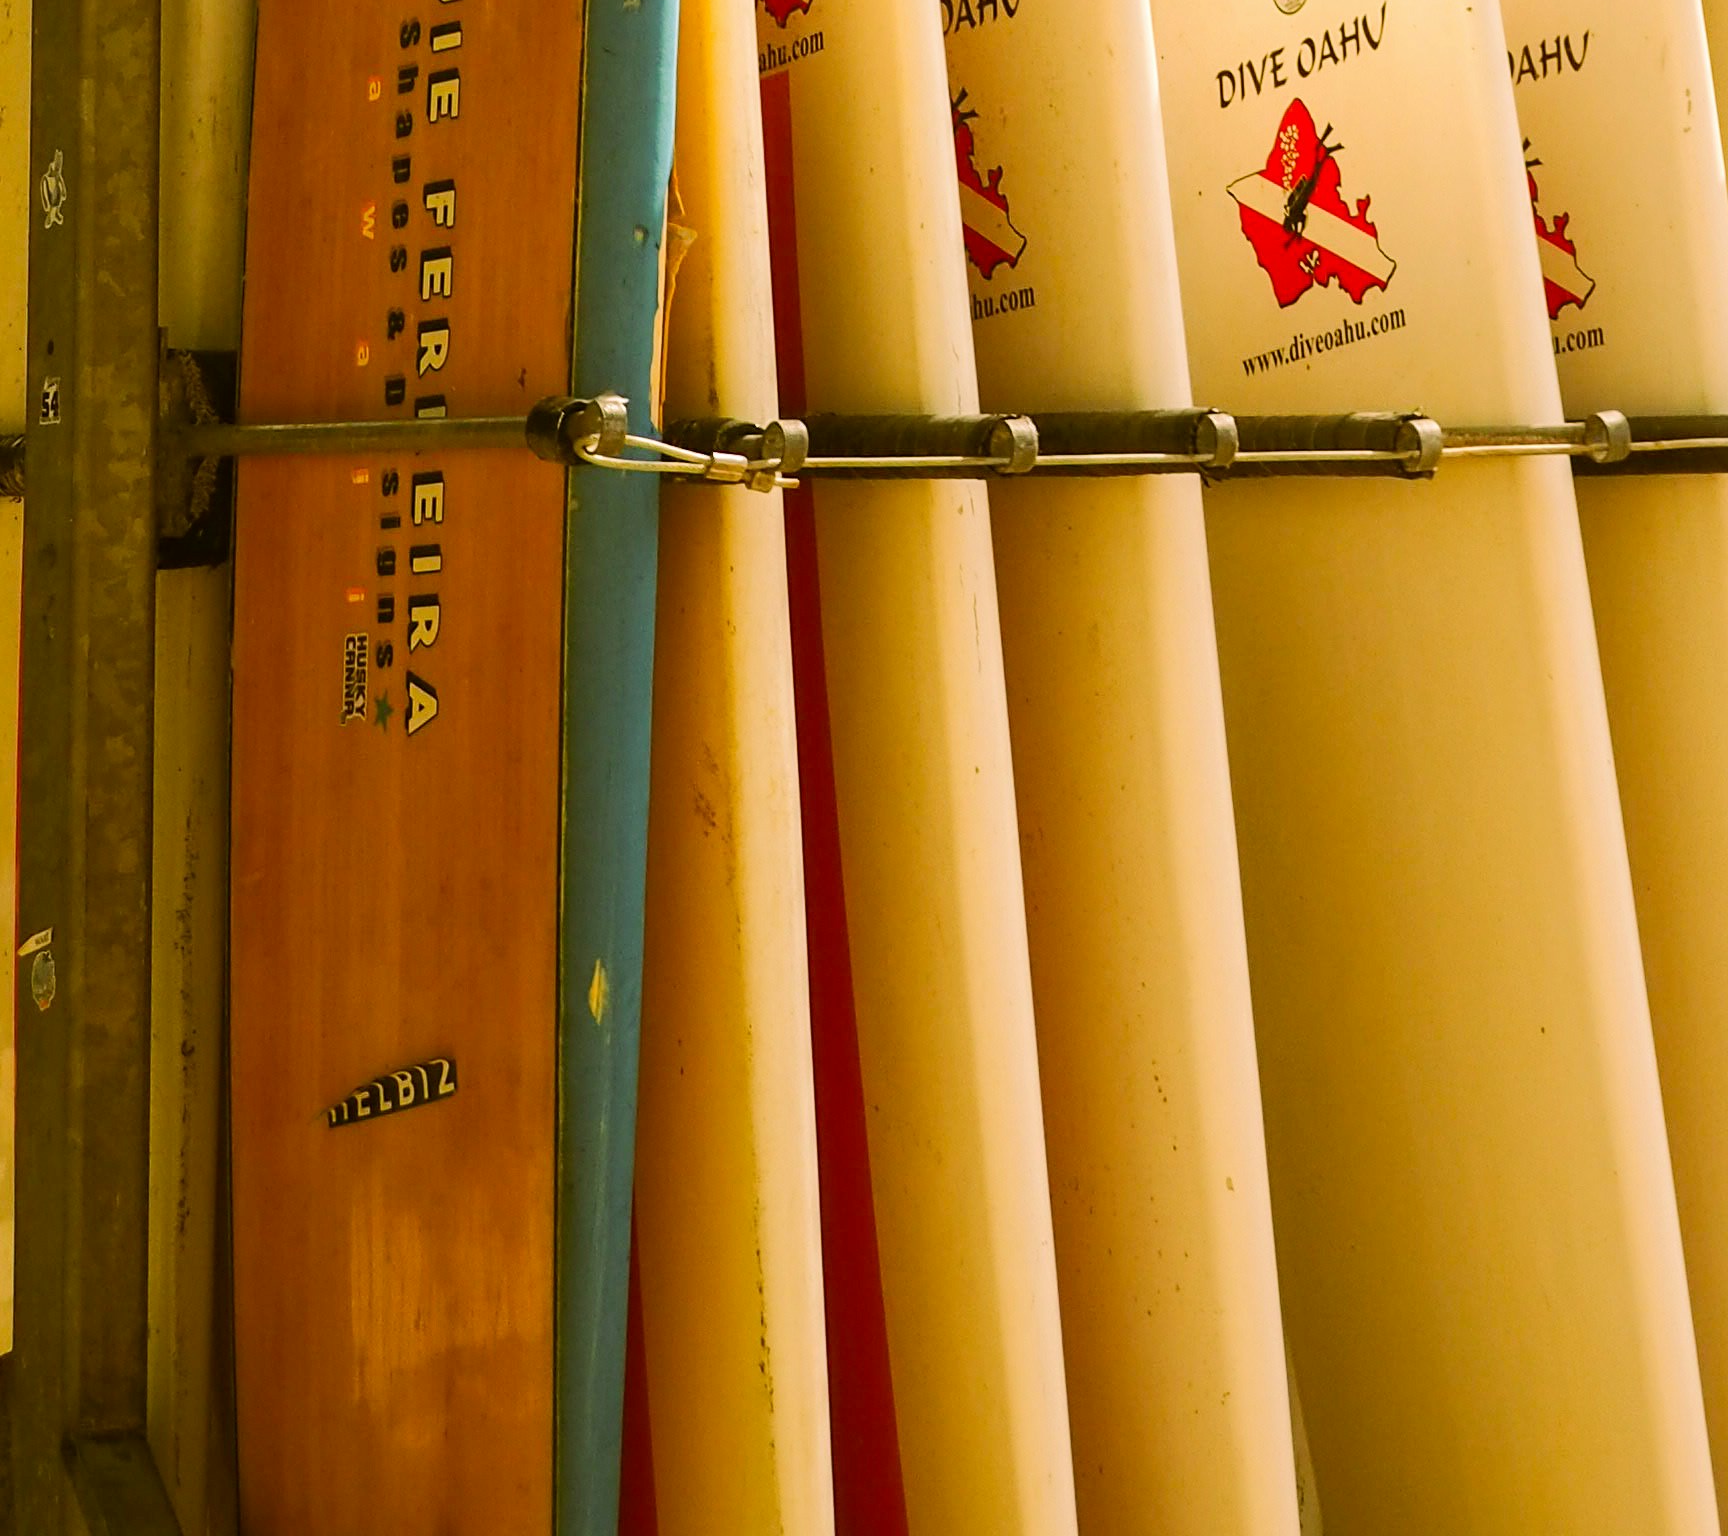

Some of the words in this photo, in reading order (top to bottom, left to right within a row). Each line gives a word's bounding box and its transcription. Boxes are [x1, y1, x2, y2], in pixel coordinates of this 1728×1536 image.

[1215, 46, 1288, 109] DIVE
[1296, 0, 1387, 79] OAHU
[389, 18, 421, 274] Shapes
[388, 307, 406, 341] &
[1242, 307, 1407, 378] www.diveoahu.com
[375, 375, 406, 669] Dsigns
[355, 634, 368, 719] HUSKY
